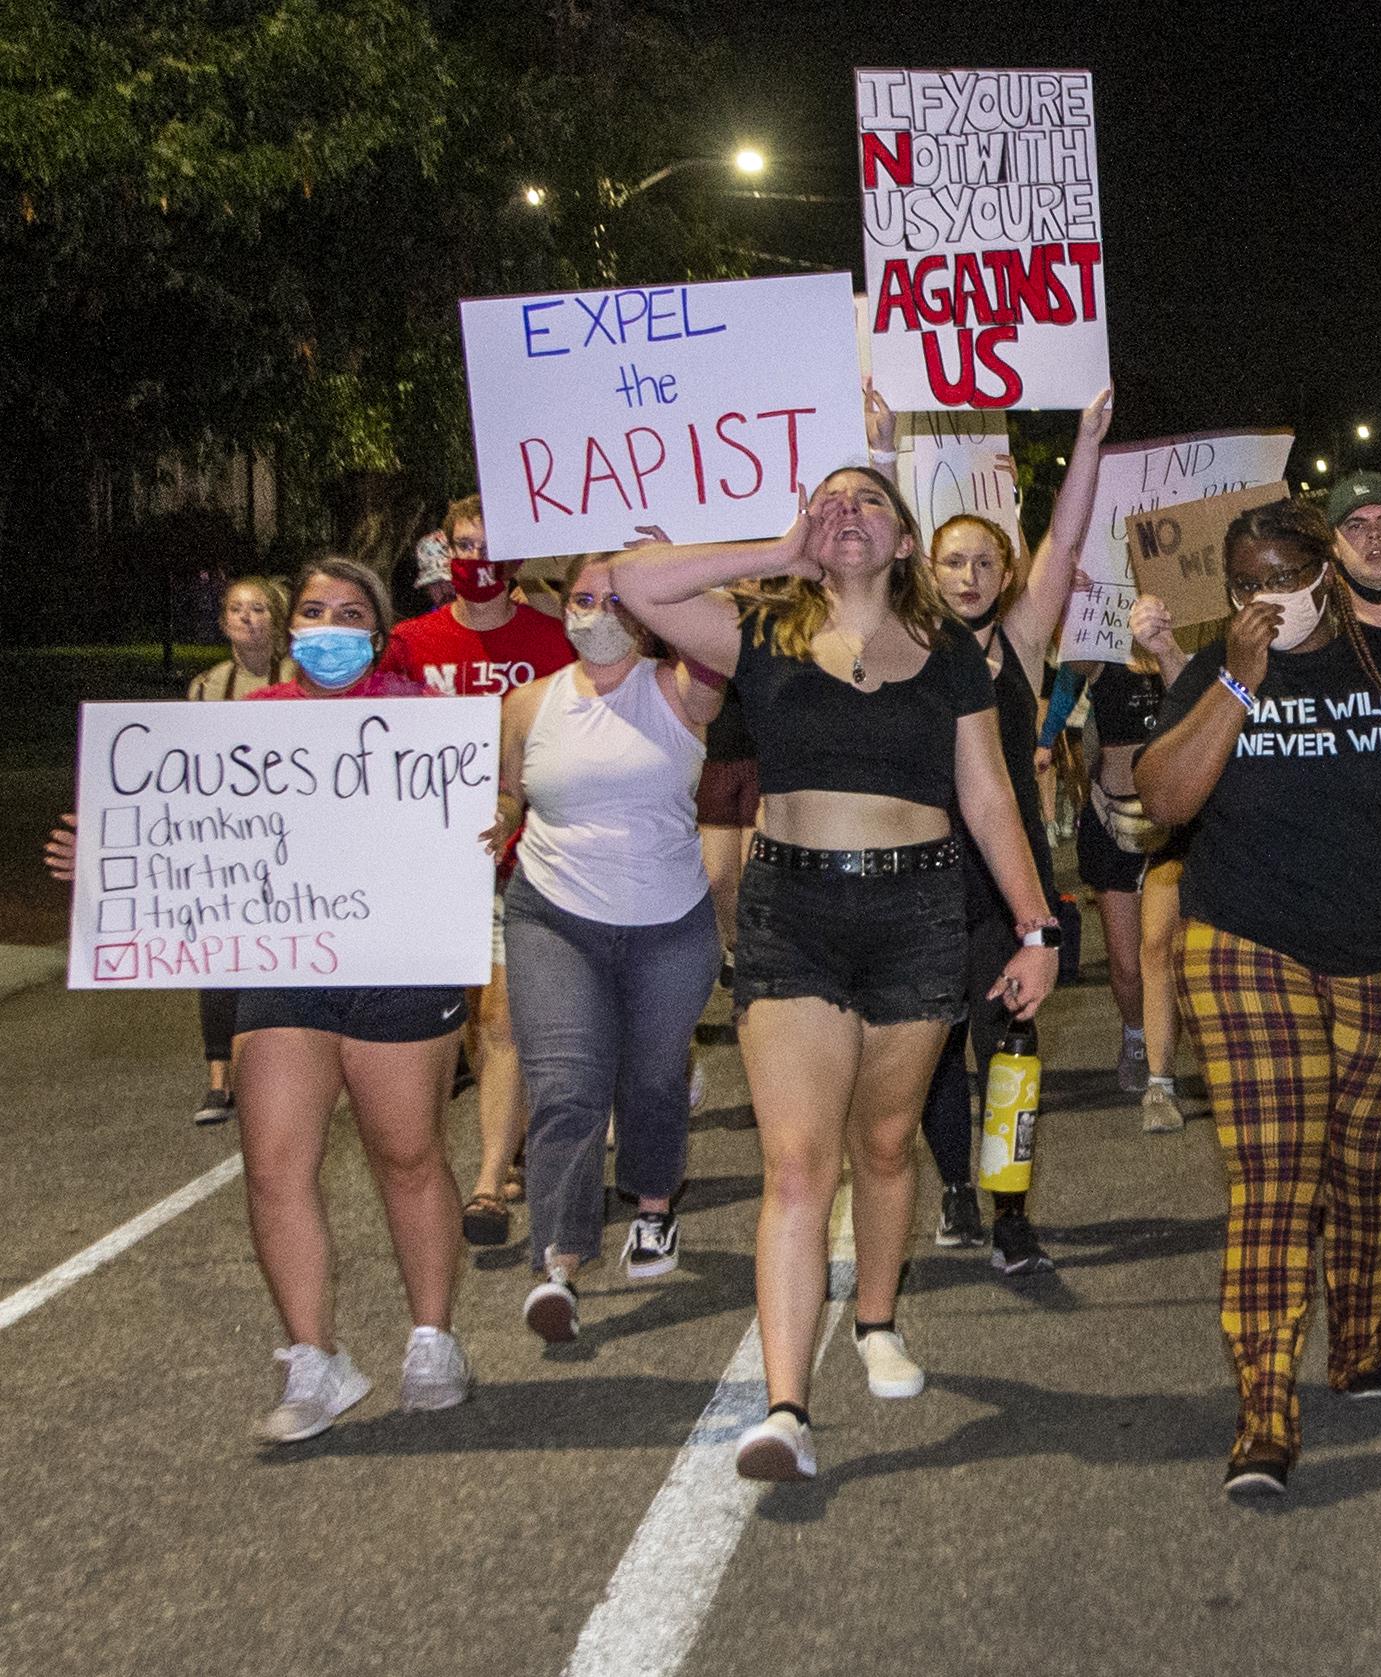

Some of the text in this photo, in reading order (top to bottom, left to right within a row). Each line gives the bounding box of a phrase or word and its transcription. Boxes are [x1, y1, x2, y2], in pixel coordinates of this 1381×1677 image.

[874, 242, 1101, 334] AGAINST
[521, 287, 728, 358] EXPEL
[615, 363, 679, 408] the
[921, 324, 1024, 409] US
[518, 407, 817, 524] RAPIST
[1141, 443, 1216, 493] END
[472, 660, 535, 696] 150
[110, 715, 492, 829] Causes of rape:
[1236, 732, 1338, 758] NEVER
[147, 802, 289, 866] drinking
[145, 854, 273, 903] flirting
[143, 882, 371, 943] tight clothes
[144, 931, 339, 978] RAPISTS
